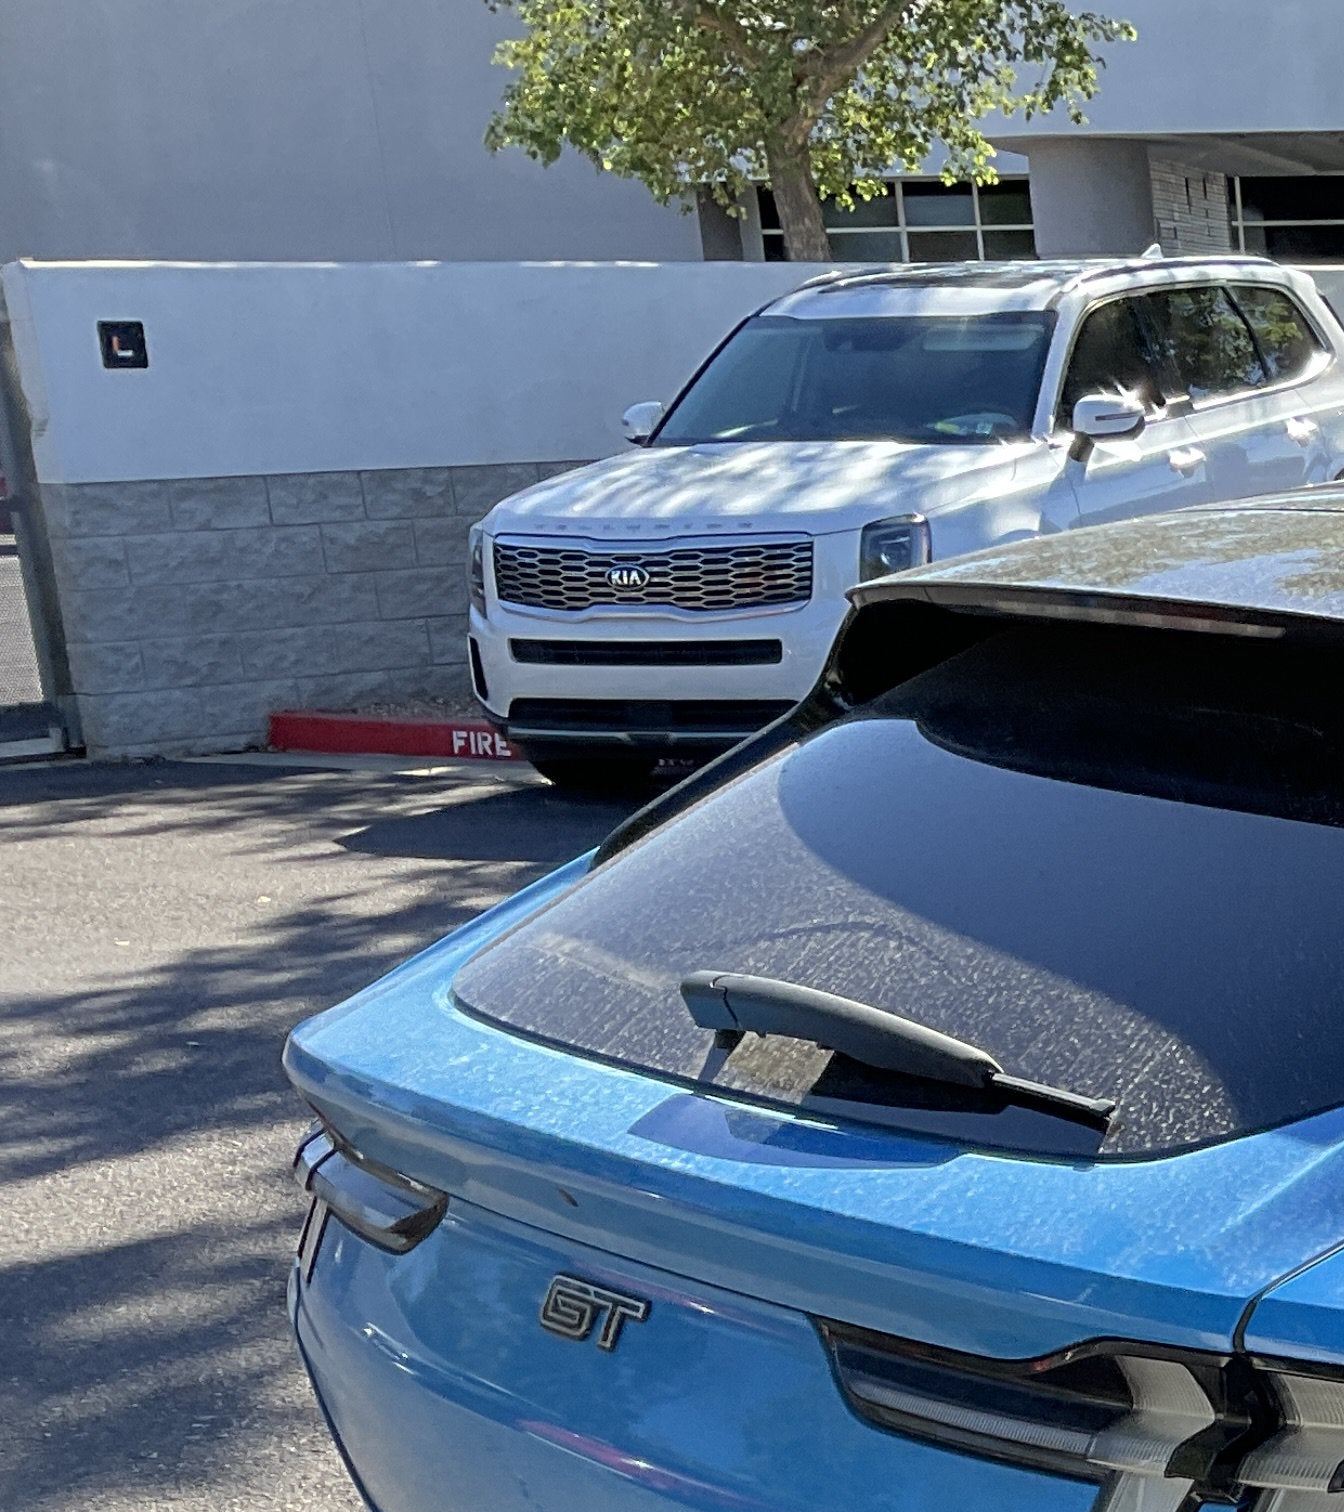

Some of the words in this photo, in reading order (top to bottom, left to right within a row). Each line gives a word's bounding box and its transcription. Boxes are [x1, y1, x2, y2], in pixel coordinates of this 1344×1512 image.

[611, 570, 642, 585] KIA
[453, 730, 512, 757] FIRE
[540, 1273, 650, 1350] GT
